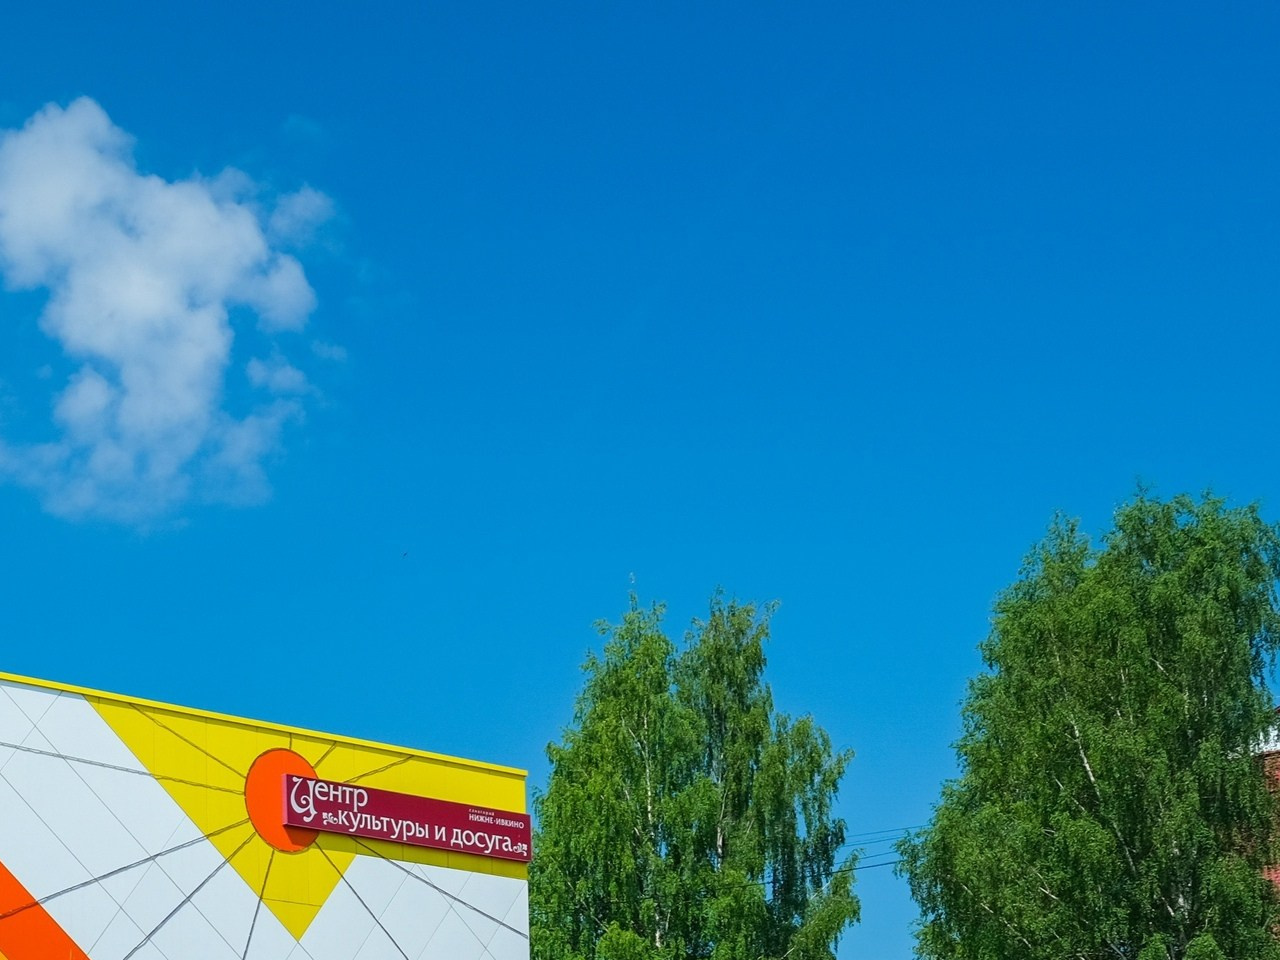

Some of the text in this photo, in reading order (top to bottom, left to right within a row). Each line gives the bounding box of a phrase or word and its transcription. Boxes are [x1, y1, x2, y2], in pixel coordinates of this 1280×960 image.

[290, 776, 368, 822] Центр
[338, 809, 512, 854] культуры и досуга
